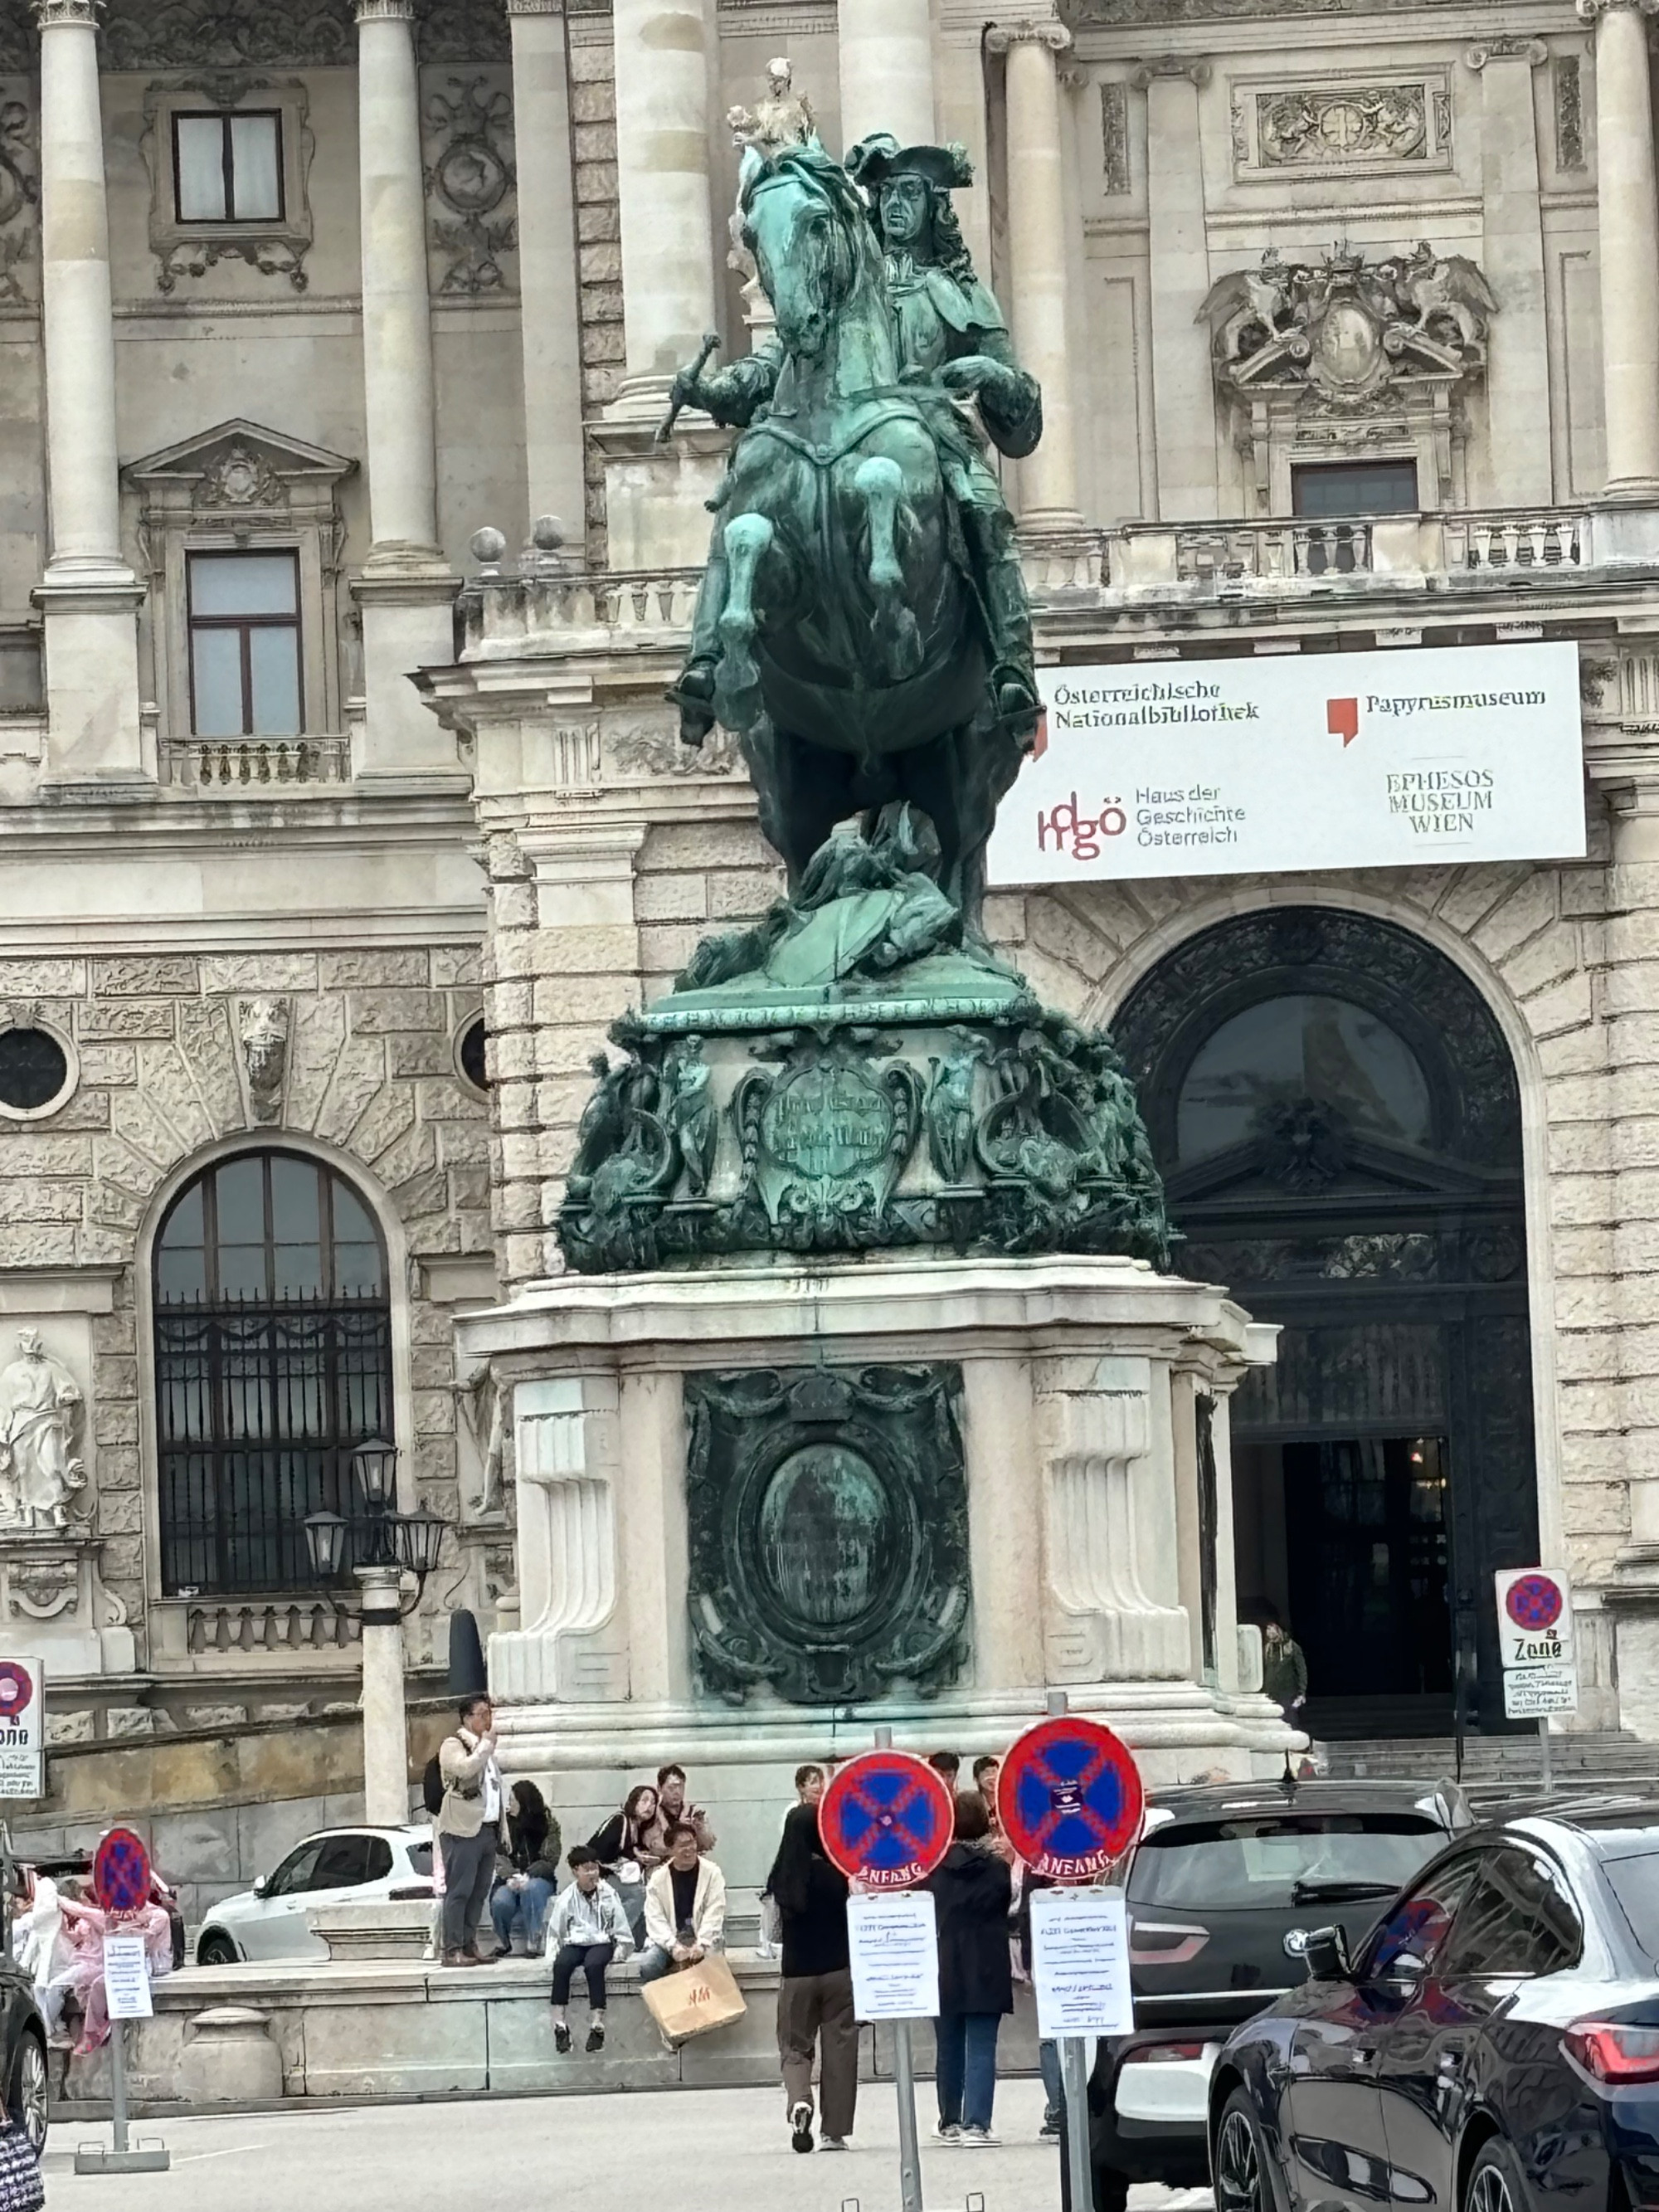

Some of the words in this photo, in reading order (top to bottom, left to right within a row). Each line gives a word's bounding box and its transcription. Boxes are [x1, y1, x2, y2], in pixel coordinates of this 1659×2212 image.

[1386, 769, 1494, 793] EPHESOS
[1136, 787, 1185, 804] Haus
[1189, 784, 1220, 801] der
[1389, 791, 1492, 814] MUSEUM
[1136, 805, 1246, 826] Geschichte
[1408, 812, 1473, 834] WIEN
[1137, 826, 1238, 847] Österreich
[1512, 1638, 1562, 1661] Zone
